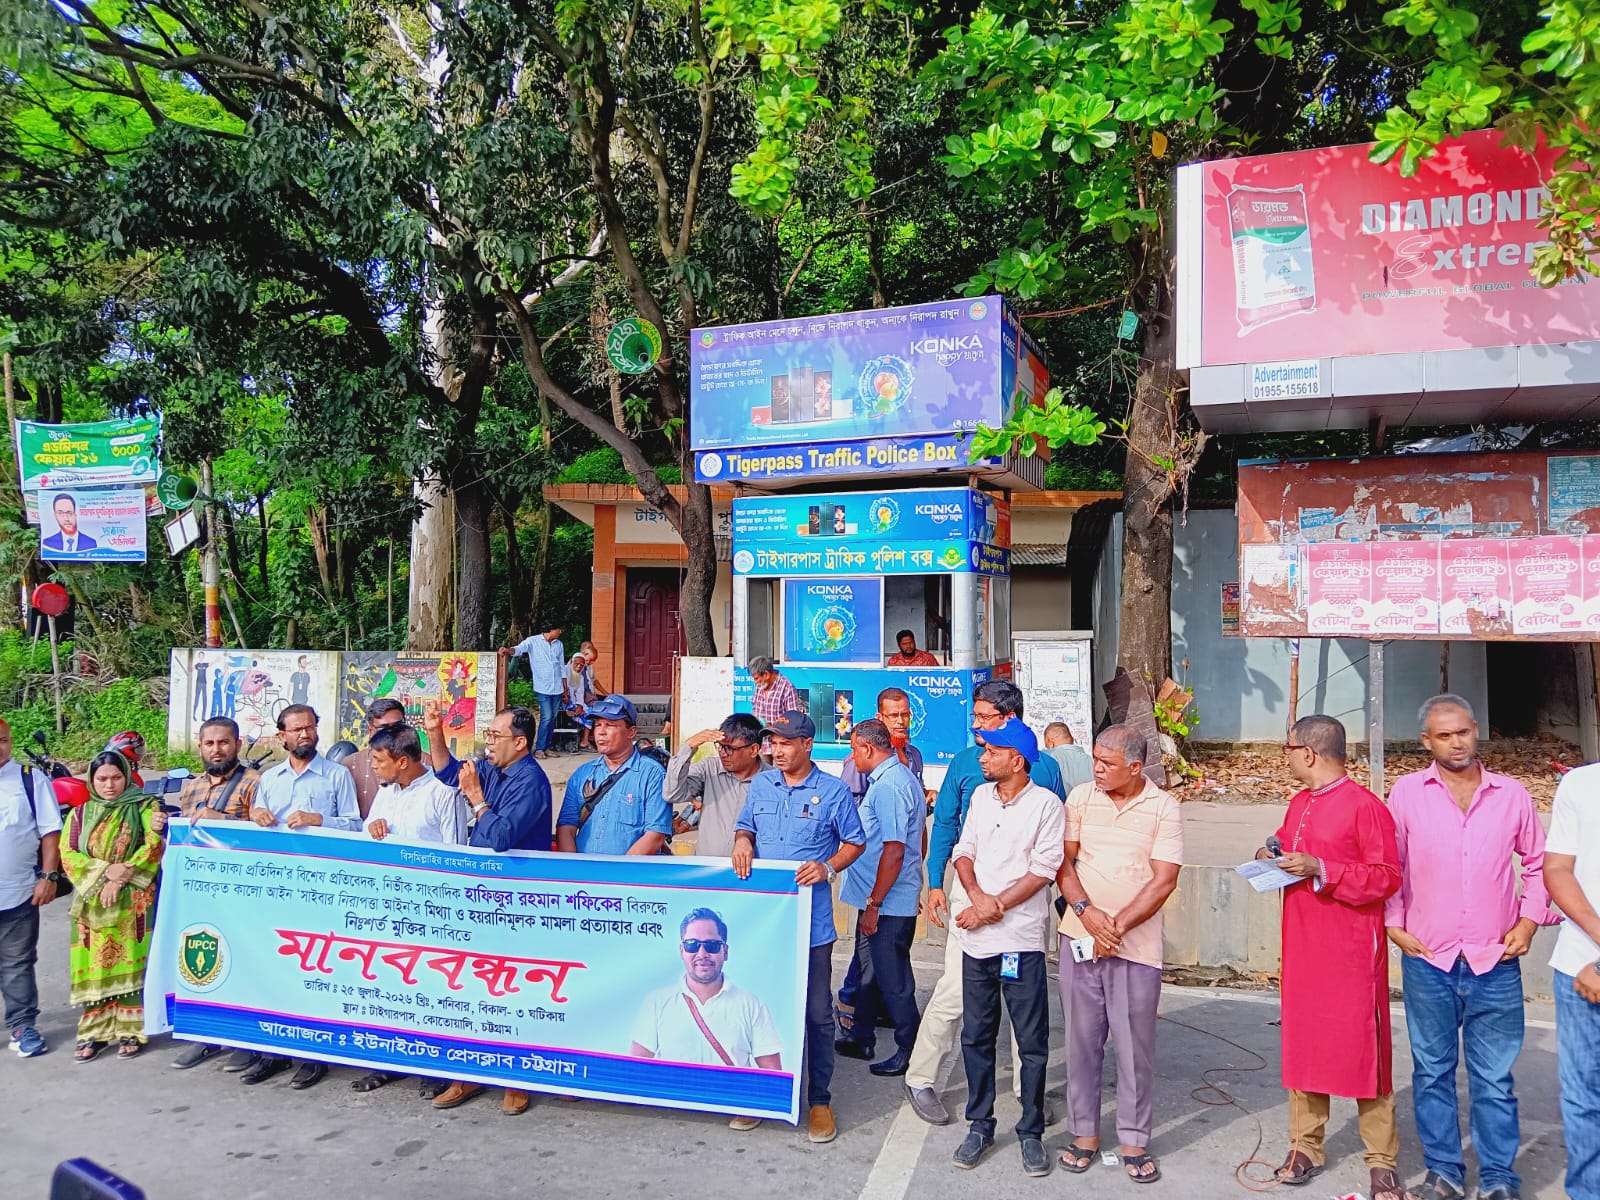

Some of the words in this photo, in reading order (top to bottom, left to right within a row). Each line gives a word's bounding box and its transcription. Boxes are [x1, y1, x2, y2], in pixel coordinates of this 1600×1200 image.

[1362, 187, 1554, 235] DIAMOND
[1362, 287, 1446, 300] POWERFUL
[1453, 281, 1513, 294] GLOBAL
[1522, 275, 1592, 290] CEENT
[723, 331, 745, 344] ট্রাফিক
[747, 328, 766, 343] আইন
[808, 321, 826, 334] নিজে
[828, 317, 855, 333] নিরাপদ
[910, 311, 938, 323] নিরাপদ
[940, 308, 961, 320] রাখুন
[910, 335, 984, 355] KONKA
[1254, 364, 1318, 383] Advertainment
[1254, 382, 1319, 398] 01955-155618
[43, 439, 89, 453] এডমিশন
[727, 454, 804, 477] Tigerpass
[808, 447, 862, 470] Traffic
[866, 445, 919, 467] Police
[923, 442, 958, 464] Box
[916, 504, 962, 515] KONKA
[756, 548, 822, 571] টাইগারপাস
[824, 545, 867, 570] ট্রাফিক
[870, 545, 907, 572] পুলিশ
[910, 550, 934, 568] বক্স
[807, 585, 853, 595] KONKA
[909, 676, 962, 688] KONKA
[444, 857, 477, 870] রাহমানির
[479, 860, 503, 872] রাহিম
[185, 857, 216, 871] দৈনিক
[220, 861, 242, 876] ঢাকা
[296, 865, 327, 883] বিশেষ
[330, 869, 379, 892] প্রতিবেদক,
[383, 875, 412, 893] নির্ভীক
[416, 883, 461, 900] সাংবাদিক
[464, 884, 514, 909] হাফিজুর
[516, 893, 561, 909] রহমান
[565, 890, 623, 912] শফিকের
[626, 897, 668, 916] বিরুদ্ধে
[183, 880, 231, 899] দায়েরকৃত
[234, 883, 263, 898] কালো
[266, 886, 293, 901] আইন
[338, 891, 378, 910] নিরাপত্তা
[424, 900, 451, 920] মিথ্যা
[455, 910, 464, 921] ও
[468, 909, 536, 932] হয়রানিমূলক
[540, 916, 576, 933] মামলা
[580, 918, 632, 936] প্রত্যাহার
[637, 922, 664, 939] এবং
[345, 911, 388, 932] নিঃশর্ত
[391, 917, 426, 938] মুক্তির
[431, 925, 473, 943] দাবিতে
[188, 938, 217, 951] UPCC
[275, 928, 588, 1004] মানববন্ধন
[304, 978, 330, 993] তারিখ
[341, 984, 354, 996] ২৫
[437, 997, 475, 1015] শনিবার,
[515, 1009, 524, 1019] ৩
[528, 1007, 566, 1023] ঘটিকায়
[342, 1003, 359, 1016] স্থান
[369, 1005, 420, 1025] টাইগারপাস,
[423, 1014, 478, 1034] কোতোয়ালি,
[482, 1020, 513, 1036] চট্টগ্রাম
[258, 1020, 334, 1045] আয়োজনে
[352, 1031, 442, 1059] ইউনাইটেড
[447, 1047, 515, 1069] প্রেসক্লাব
[519, 1053, 577, 1077] চট্টগ্রাম
